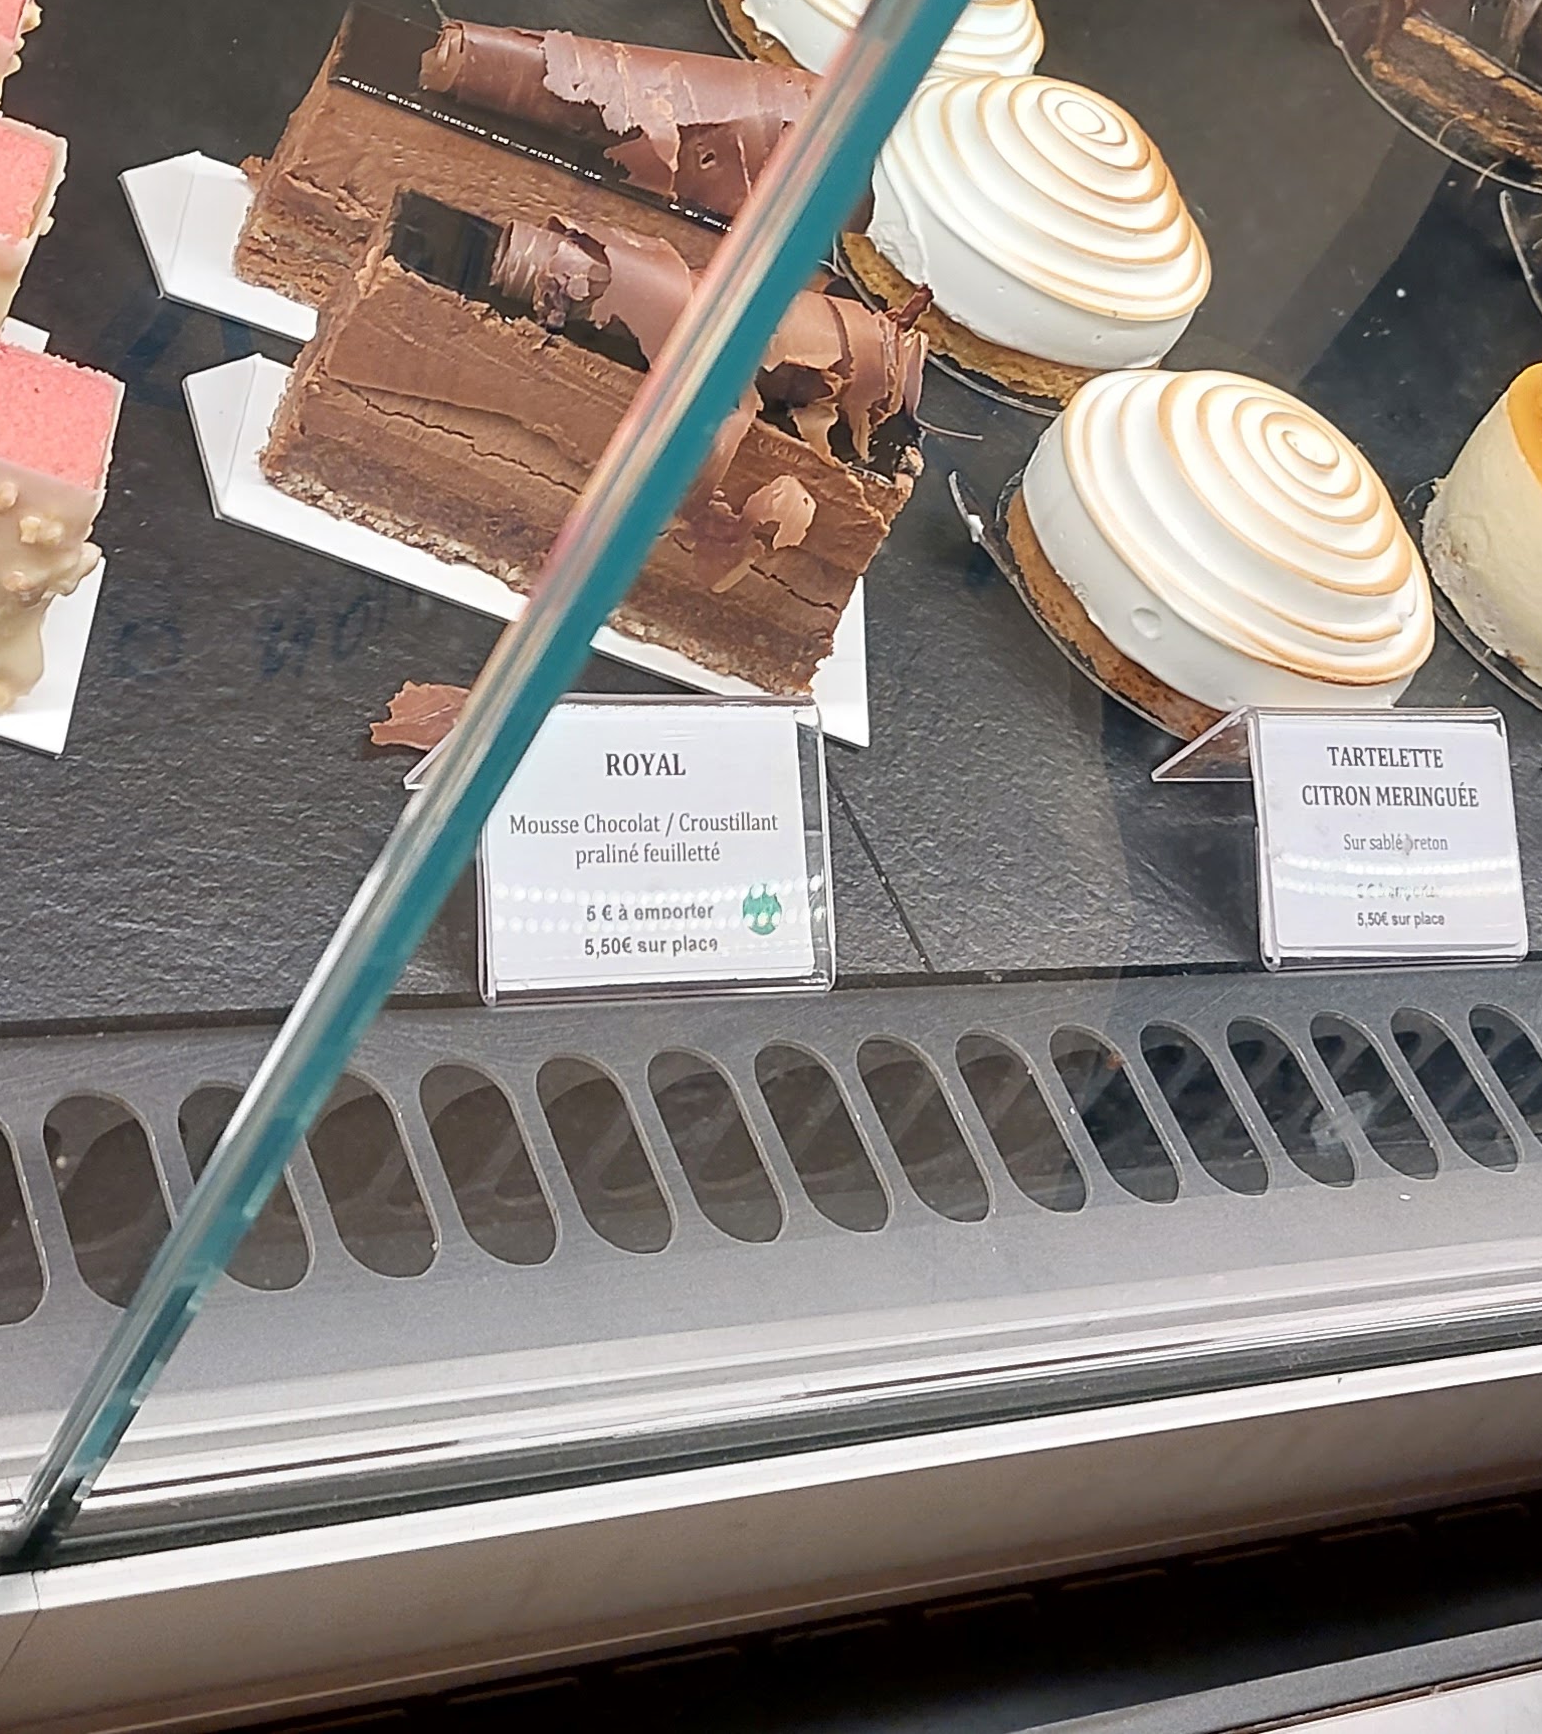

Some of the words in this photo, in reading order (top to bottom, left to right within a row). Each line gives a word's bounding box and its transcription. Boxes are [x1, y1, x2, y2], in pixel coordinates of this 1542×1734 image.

[605, 752, 686, 777] ROYAL
[1326, 746, 1444, 769] TARTELETTE
[1302, 784, 1371, 807] CITRON
[1376, 781, 1479, 808] MERINGUÉE
[509, 814, 580, 835] Mousse
[584, 812, 661, 834] Chocolat
[665, 813, 675, 838] /
[679, 811, 779, 833] Croustillant
[1343, 833, 1366, 850] Sur
[1369, 832, 1403, 851] sablé
[575, 842, 639, 869] praliné
[643, 841, 721, 863] feuilletté
[586, 905, 596, 922] 5
[602, 904, 612, 921] €
[618, 903, 628, 920] à
[1357, 911, 1389, 929] 5,50€
[1391, 914, 1411, 926] sur
[1414, 911, 1445, 929] place
[584, 936, 632, 959] 5,50€
[637, 939, 667, 953] sur
[672, 934, 718, 957] place
